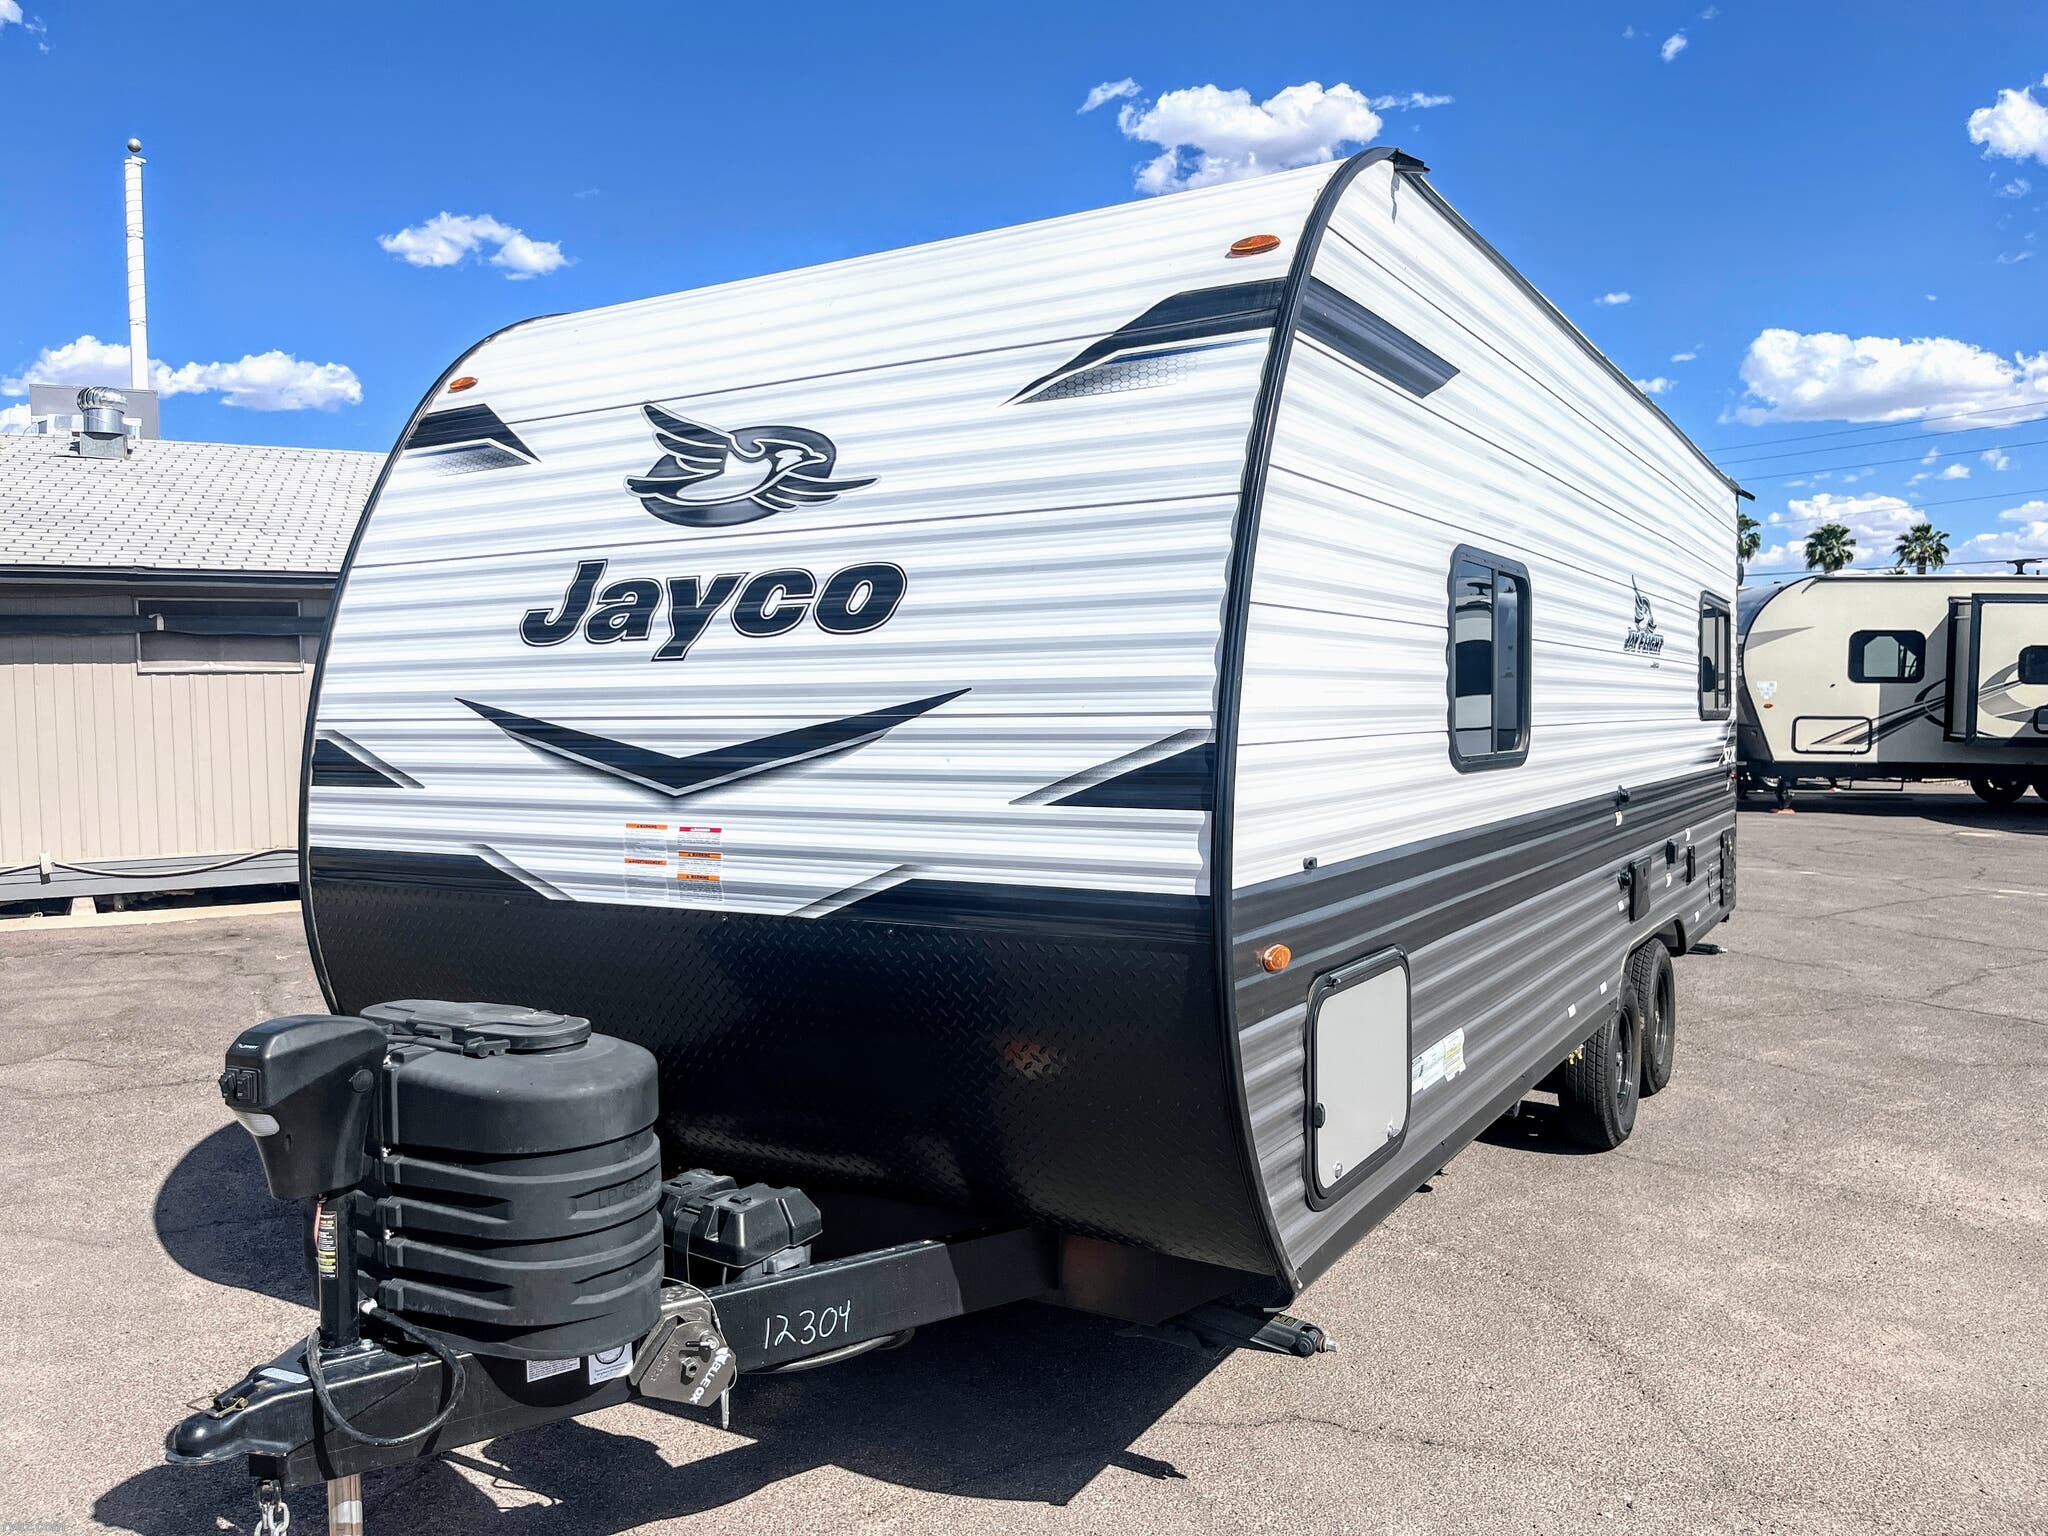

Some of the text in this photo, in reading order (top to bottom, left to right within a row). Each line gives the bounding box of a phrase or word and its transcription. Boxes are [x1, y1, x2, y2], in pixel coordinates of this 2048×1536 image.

[519, 558, 908, 662] Jayco
[764, 1299, 851, 1350] 12304
[688, 1362, 724, 1405] BLUE OX
